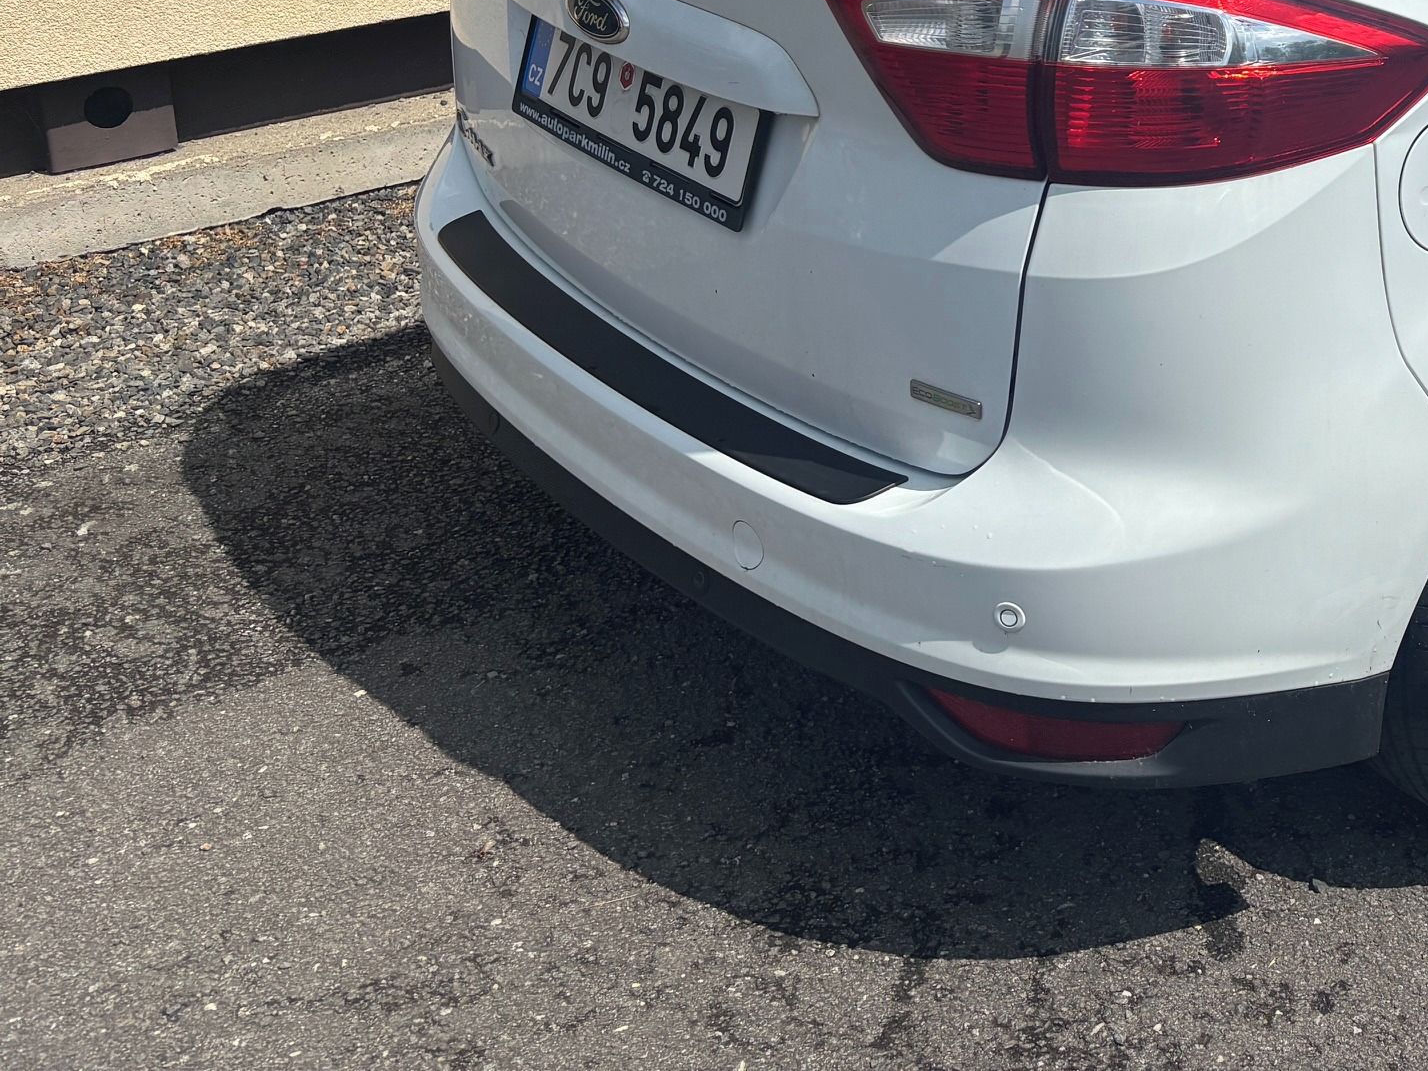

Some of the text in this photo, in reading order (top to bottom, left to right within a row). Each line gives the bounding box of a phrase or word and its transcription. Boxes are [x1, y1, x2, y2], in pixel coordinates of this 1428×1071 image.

[528, 63, 544, 87] CZ
[548, 34, 735, 179] 7C9 5849
[652, 174, 727, 222] 724 150 000
